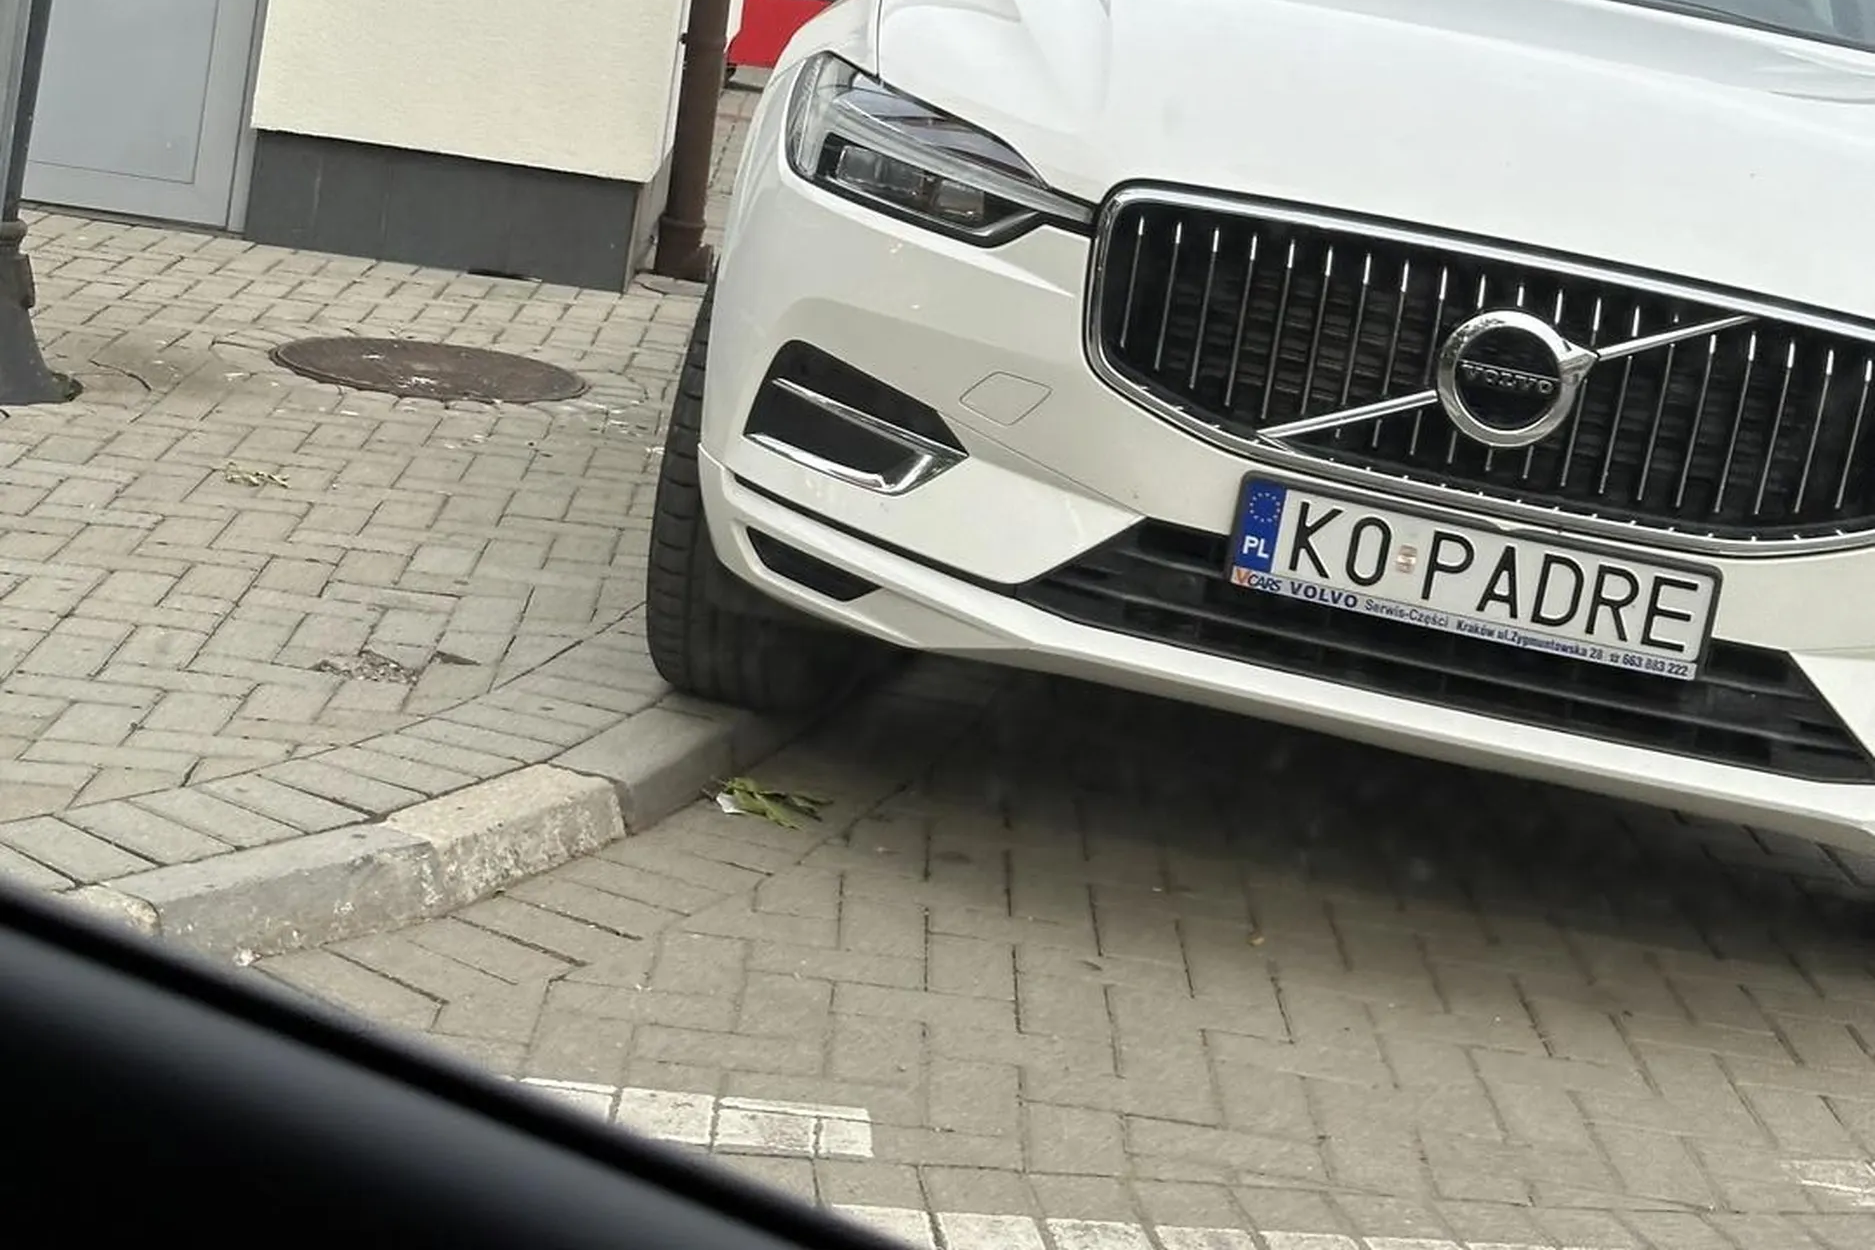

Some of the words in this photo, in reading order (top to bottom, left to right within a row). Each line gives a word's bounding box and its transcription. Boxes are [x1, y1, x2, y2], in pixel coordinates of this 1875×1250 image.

[1242, 535, 1269, 559] PL
[1421, 531, 1700, 652] PADRE
[1290, 581, 1358, 608] VOLVO
[1667, 662, 1689, 677] 222
